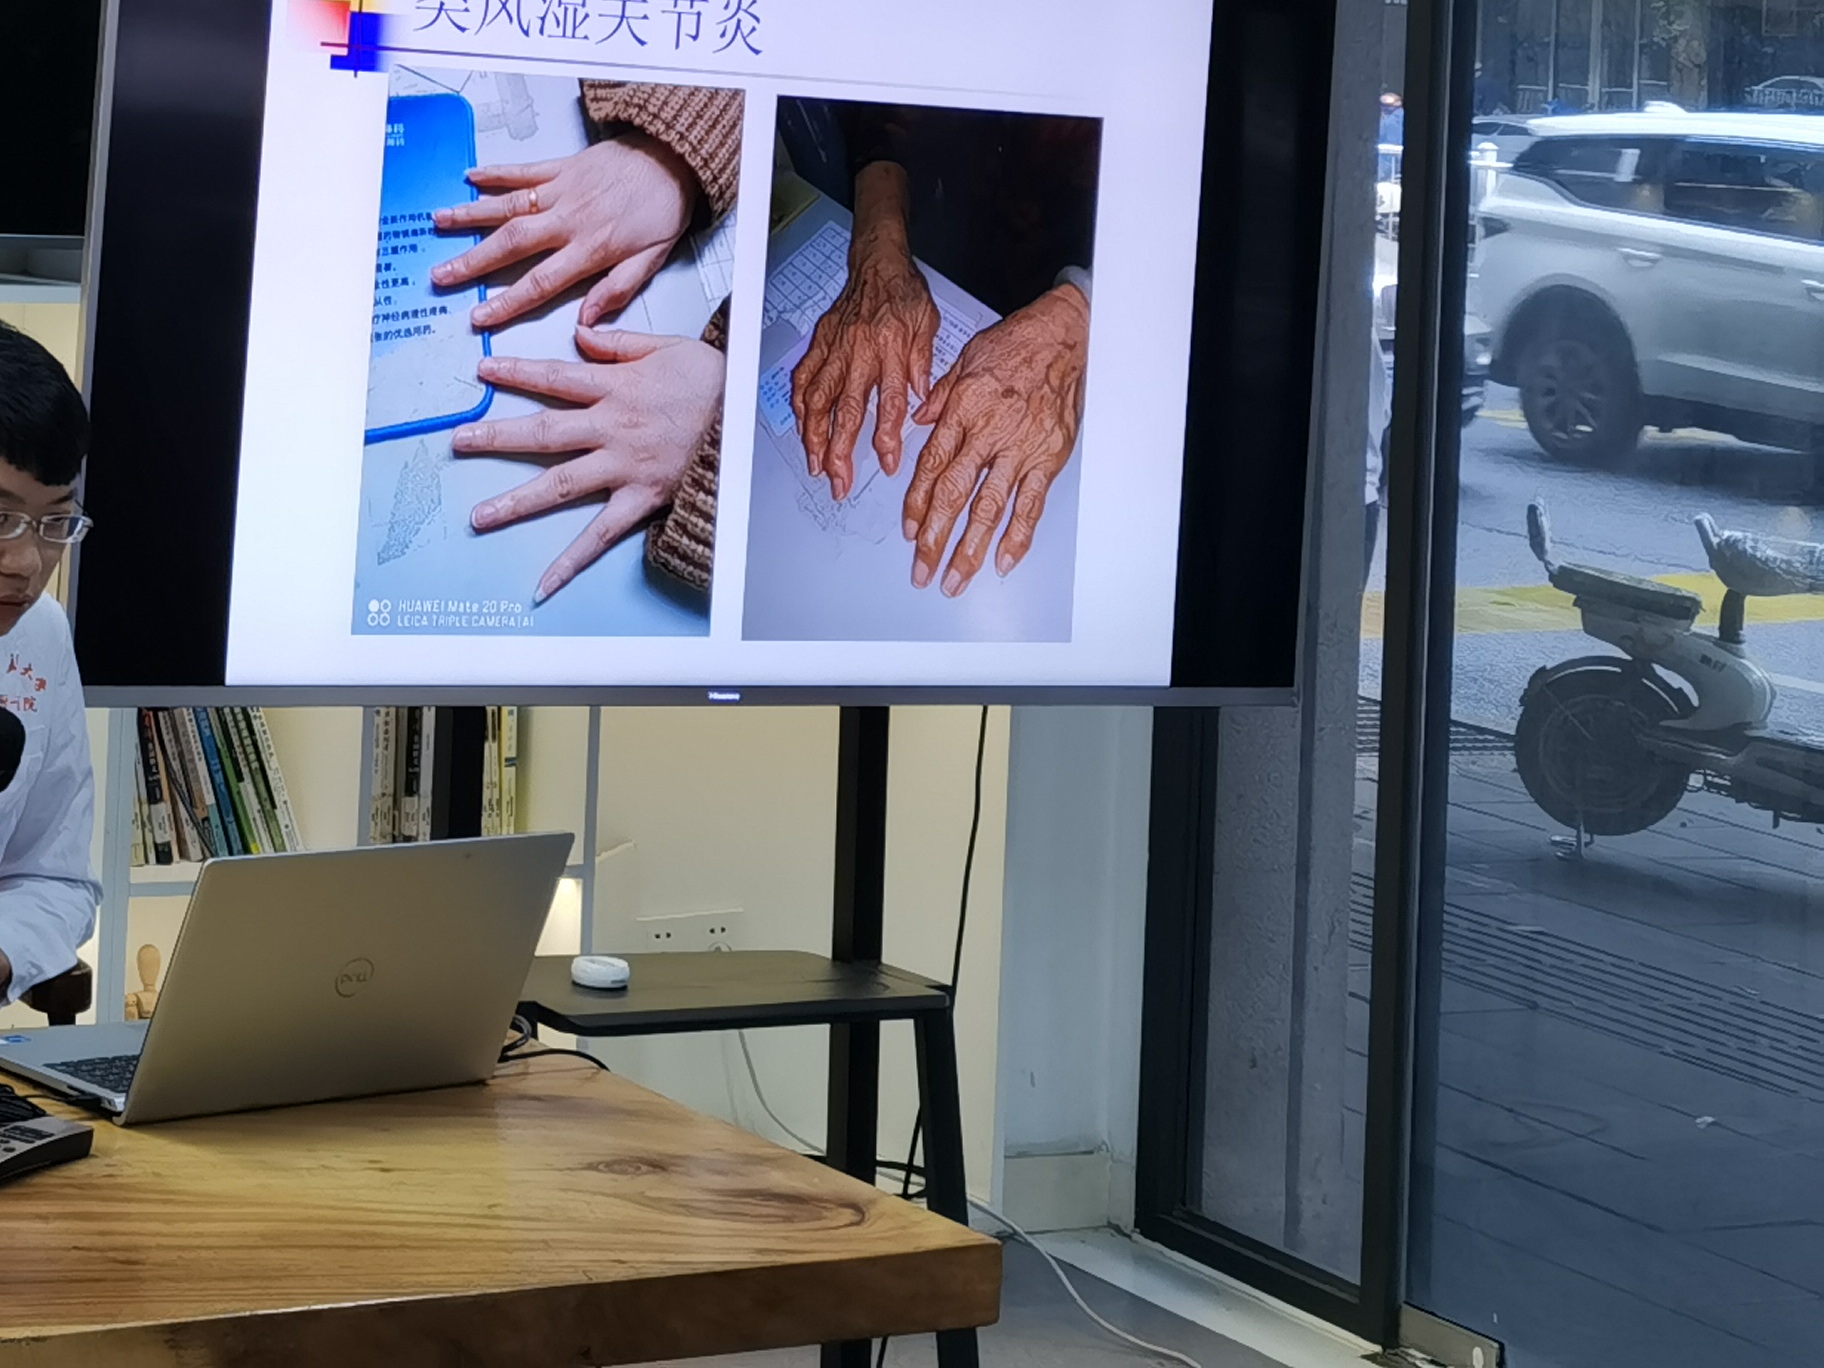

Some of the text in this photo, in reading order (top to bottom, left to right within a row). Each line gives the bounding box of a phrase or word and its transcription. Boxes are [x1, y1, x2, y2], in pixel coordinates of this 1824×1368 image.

[398, 599, 523, 614] HUAWEI Mate 20 Pro
[397, 615, 428, 627] LEICA
[432, 615, 468, 627] TRIPLE
